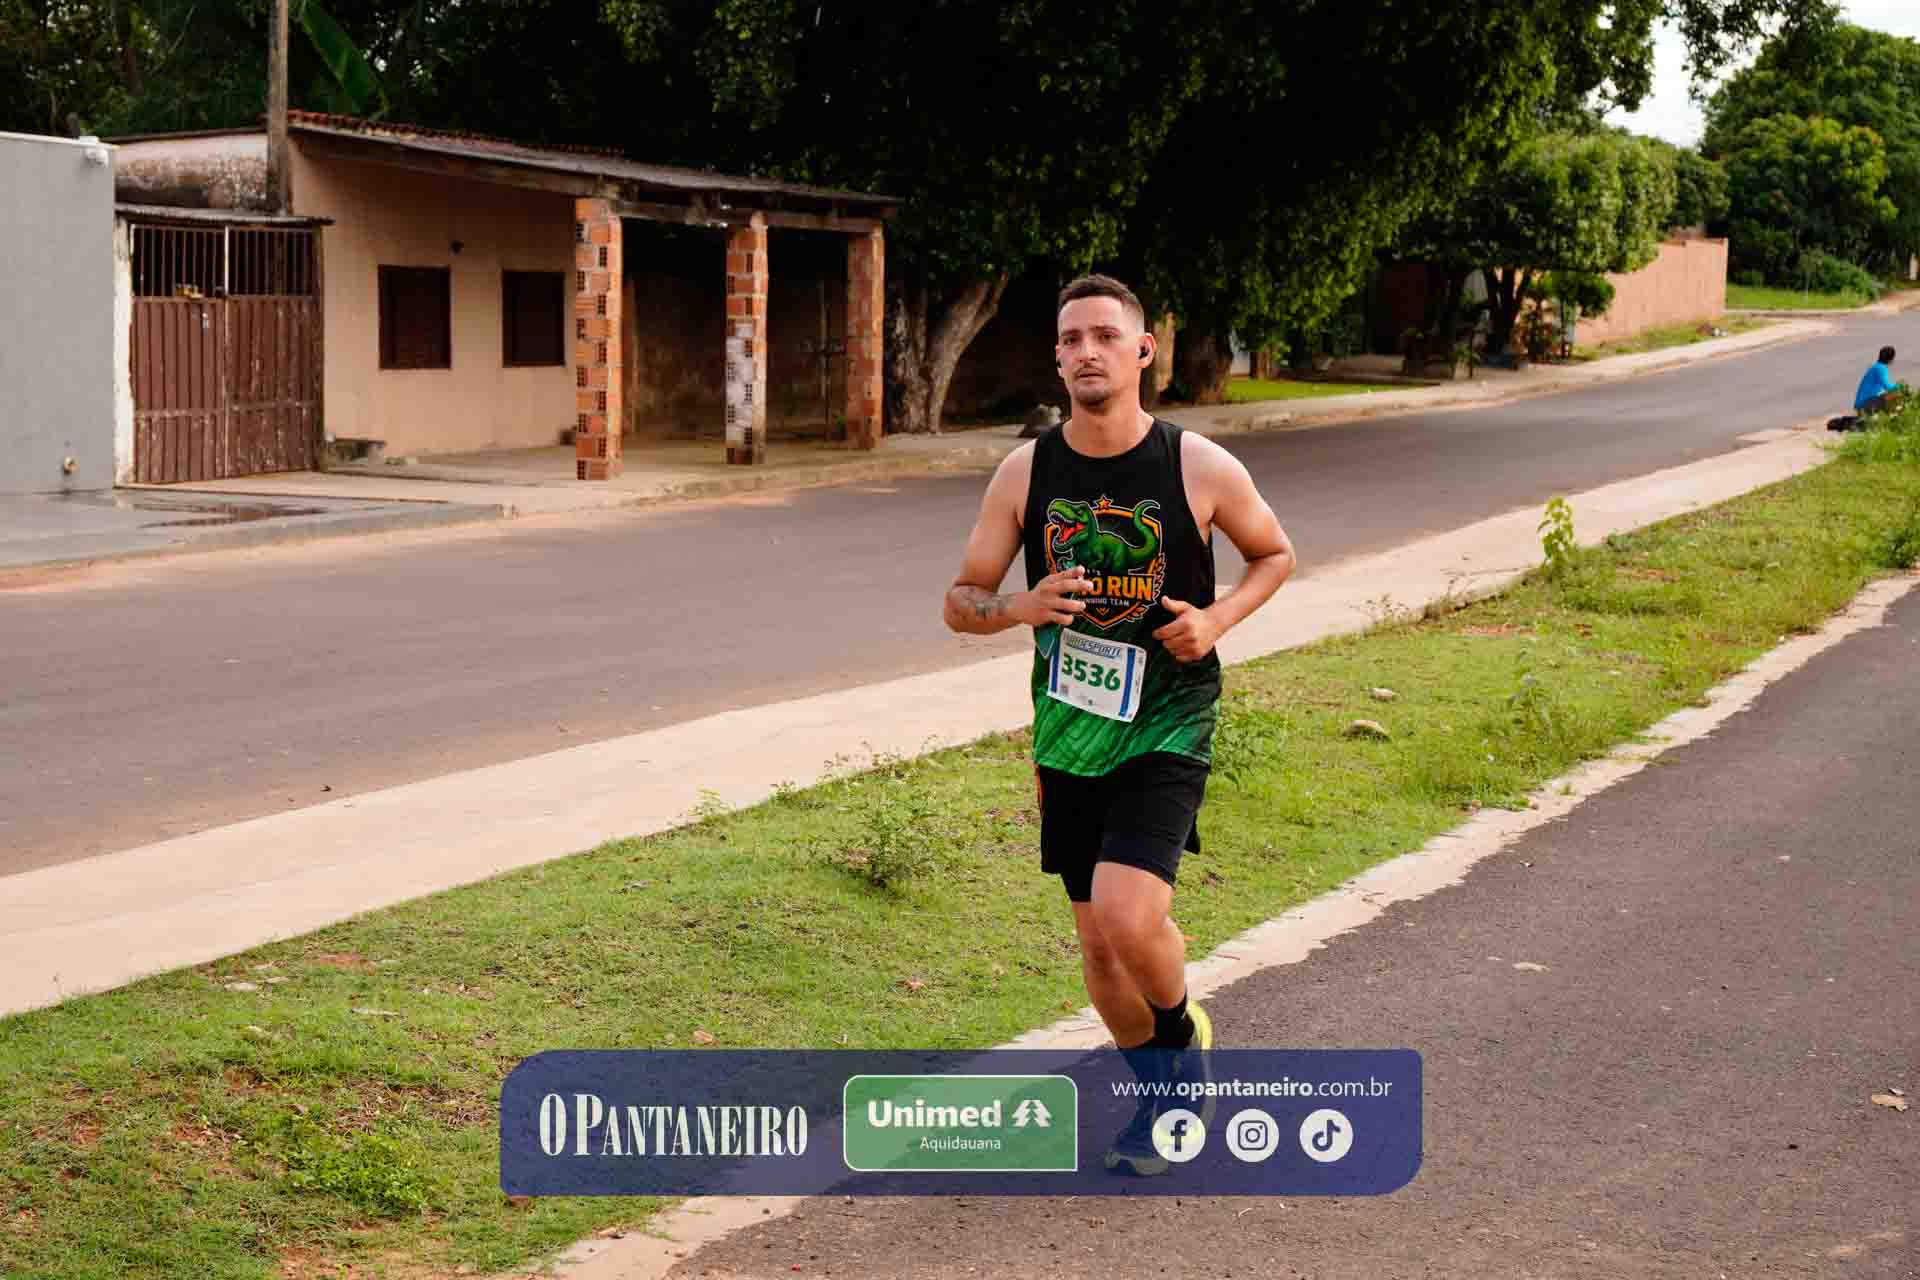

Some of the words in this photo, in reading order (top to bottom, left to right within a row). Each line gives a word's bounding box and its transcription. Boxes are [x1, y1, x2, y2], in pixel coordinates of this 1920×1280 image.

[1107, 576, 1153, 601] RUN
[1110, 598, 1130, 607] TEAM
[1062, 652, 1121, 691] 3536
